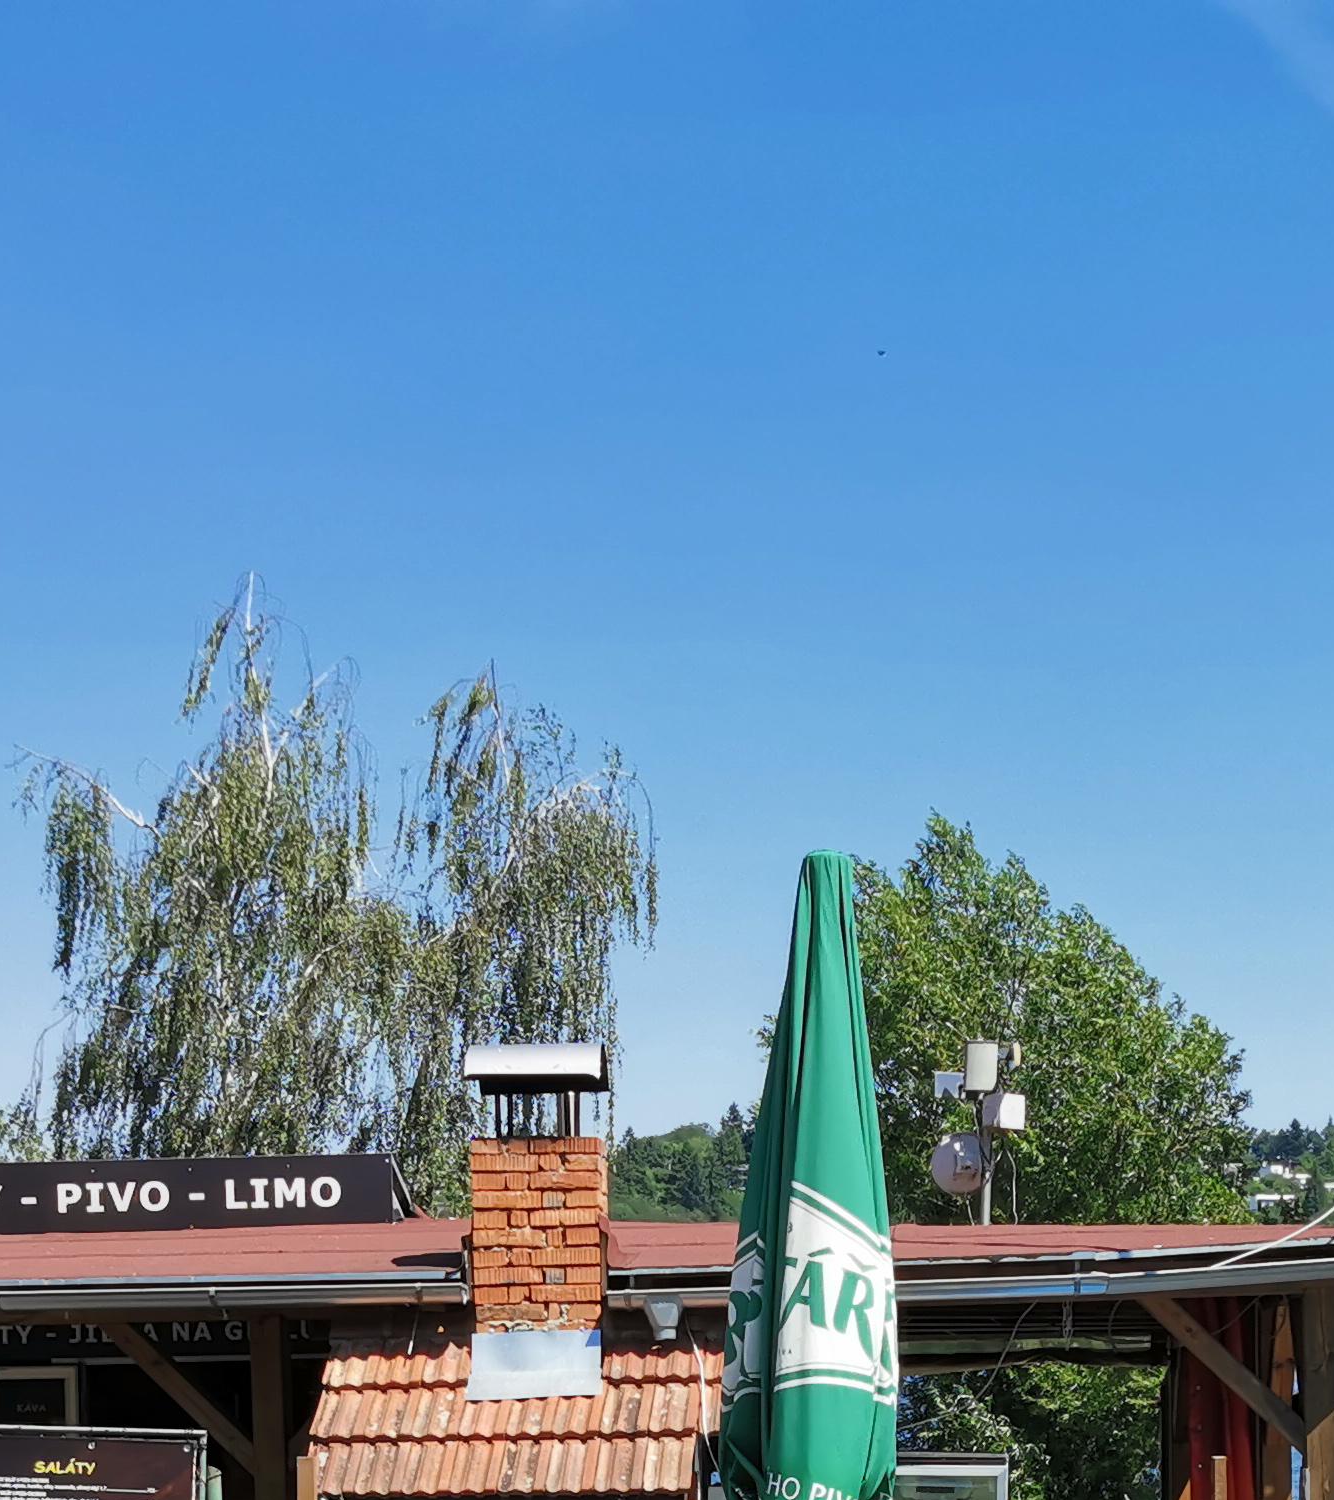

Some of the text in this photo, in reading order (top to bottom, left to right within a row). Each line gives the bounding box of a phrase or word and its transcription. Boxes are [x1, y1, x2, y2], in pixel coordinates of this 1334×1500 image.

[56, 1180, 171, 1214] PIVO
[224, 1176, 343, 1210] LIMO
[172, 1321, 212, 1343] NA
[34, 1458, 96, 1476] SALÁTY
